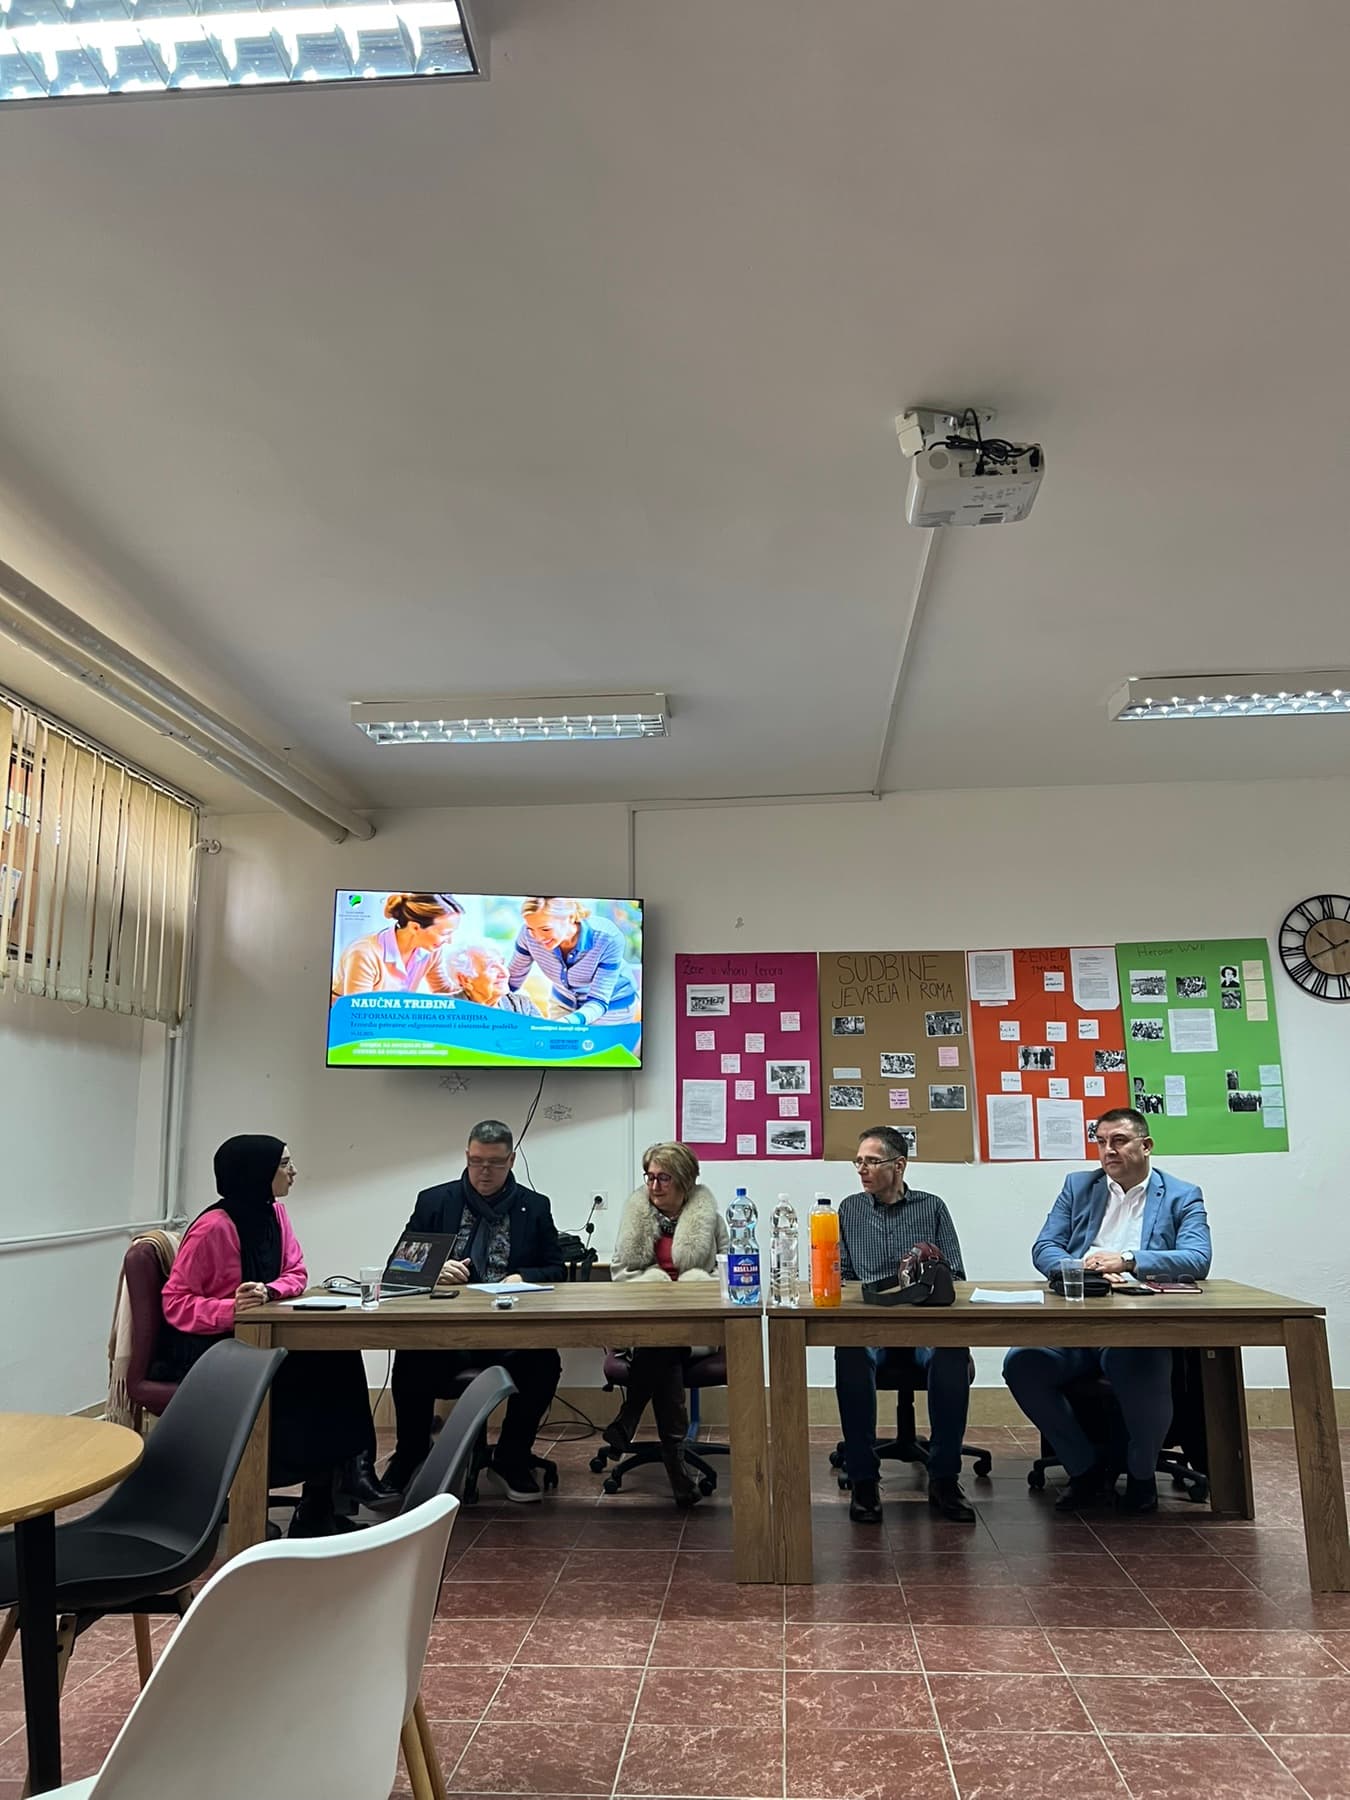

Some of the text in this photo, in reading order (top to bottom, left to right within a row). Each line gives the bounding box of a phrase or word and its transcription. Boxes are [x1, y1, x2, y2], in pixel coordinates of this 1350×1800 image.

[837, 954, 940, 985] SUDBINE
[351, 997, 456, 1010] NAUČNA TRIBINA
[832, 983, 899, 1009] JEVREJA
[919, 982, 954, 1002] ROMA
[351, 1012, 410, 1020] NEFORMALNA
